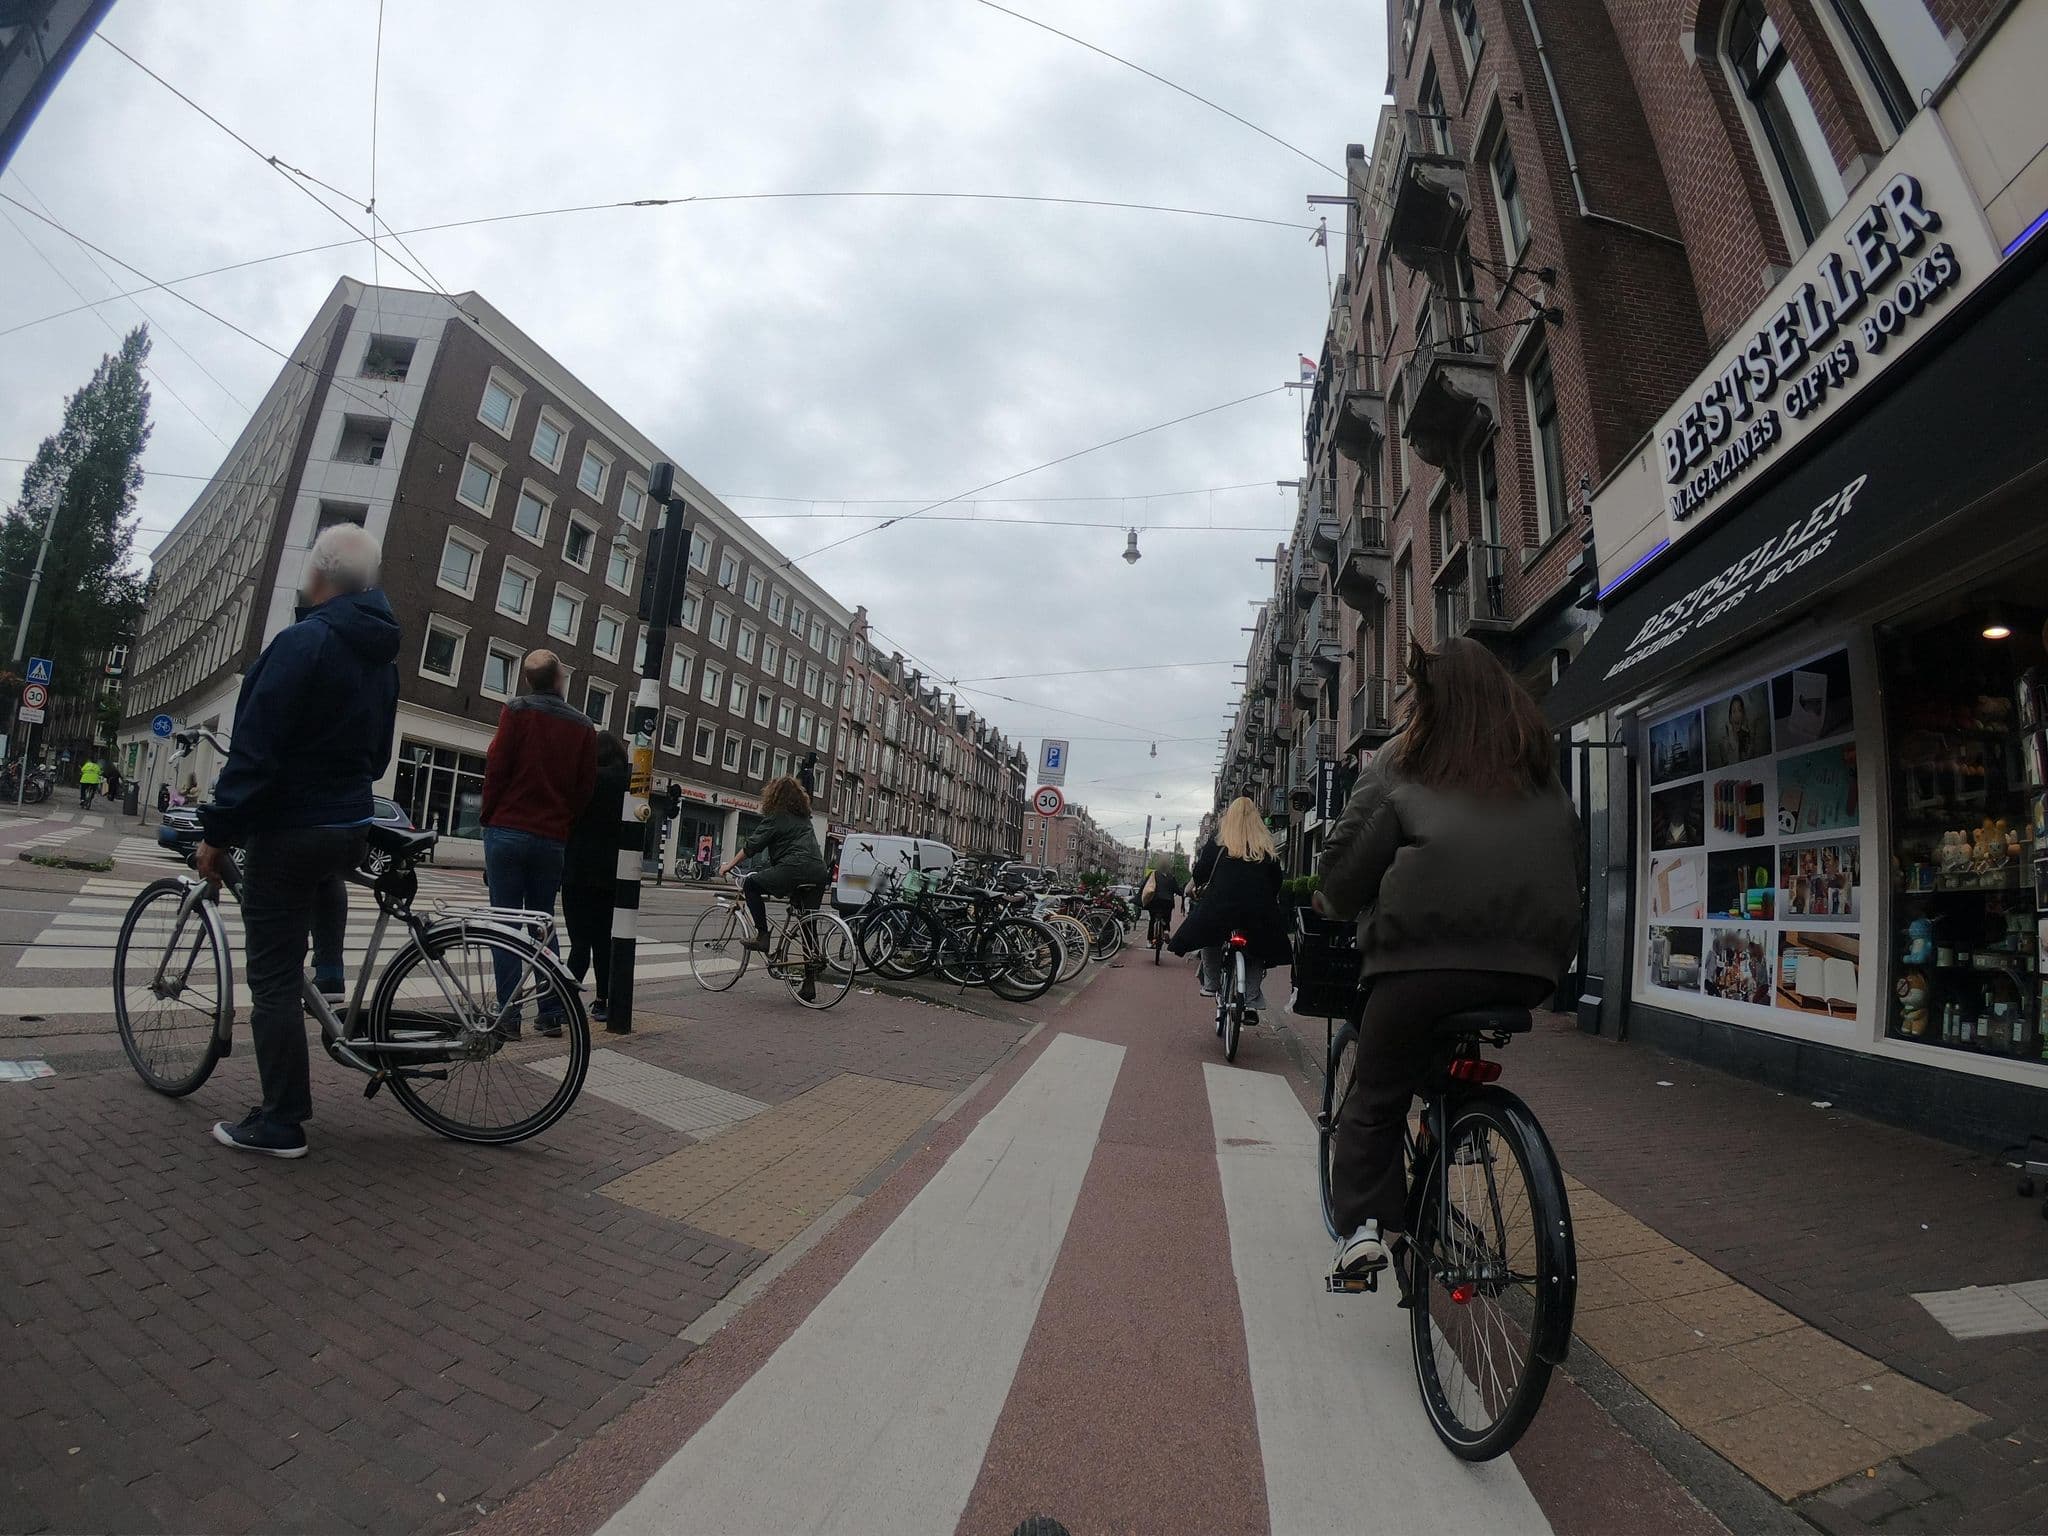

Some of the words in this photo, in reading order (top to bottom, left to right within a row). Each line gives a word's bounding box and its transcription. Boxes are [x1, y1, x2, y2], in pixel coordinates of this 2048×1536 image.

[1661, 172, 1942, 483] BESTSELLER
[1669, 410, 1782, 521] MAGAZINES
[1783, 339, 1859, 419] GIFTS
[1859, 242, 1961, 354] BOOKS
[1602, 620, 1694, 681] MAGAZINES
[1696, 584, 1753, 628] GIFTS
[1755, 529, 1838, 593] BOOKS
[1625, 474, 1868, 652] BESTSELLER
[28, 691, 43, 702] 30
[1039, 795, 1058, 808] 30
[1049, 748, 1058, 760] P
[1325, 770, 1333, 818] HOTEL
